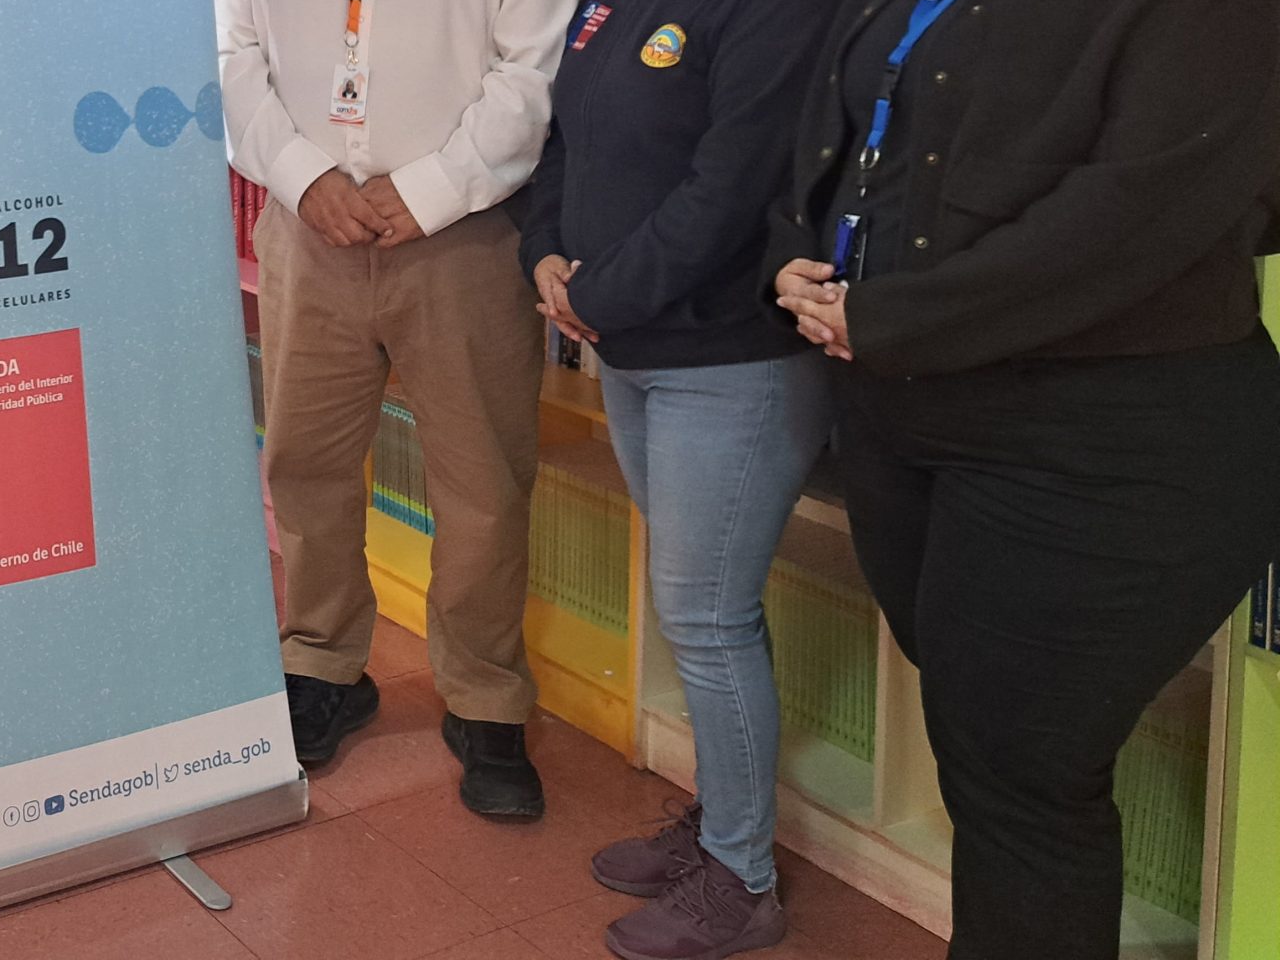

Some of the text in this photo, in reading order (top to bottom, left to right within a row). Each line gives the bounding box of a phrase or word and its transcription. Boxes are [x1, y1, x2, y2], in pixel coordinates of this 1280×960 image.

[18, 380, 35, 392] del
[36, 373, 74, 390] Interior
[26, 391, 64, 407] Pública
[32, 546, 49, 562] de
[51, 540, 84, 558] Chile
[68, 736, 273, 810] Sendagob senda_gob
